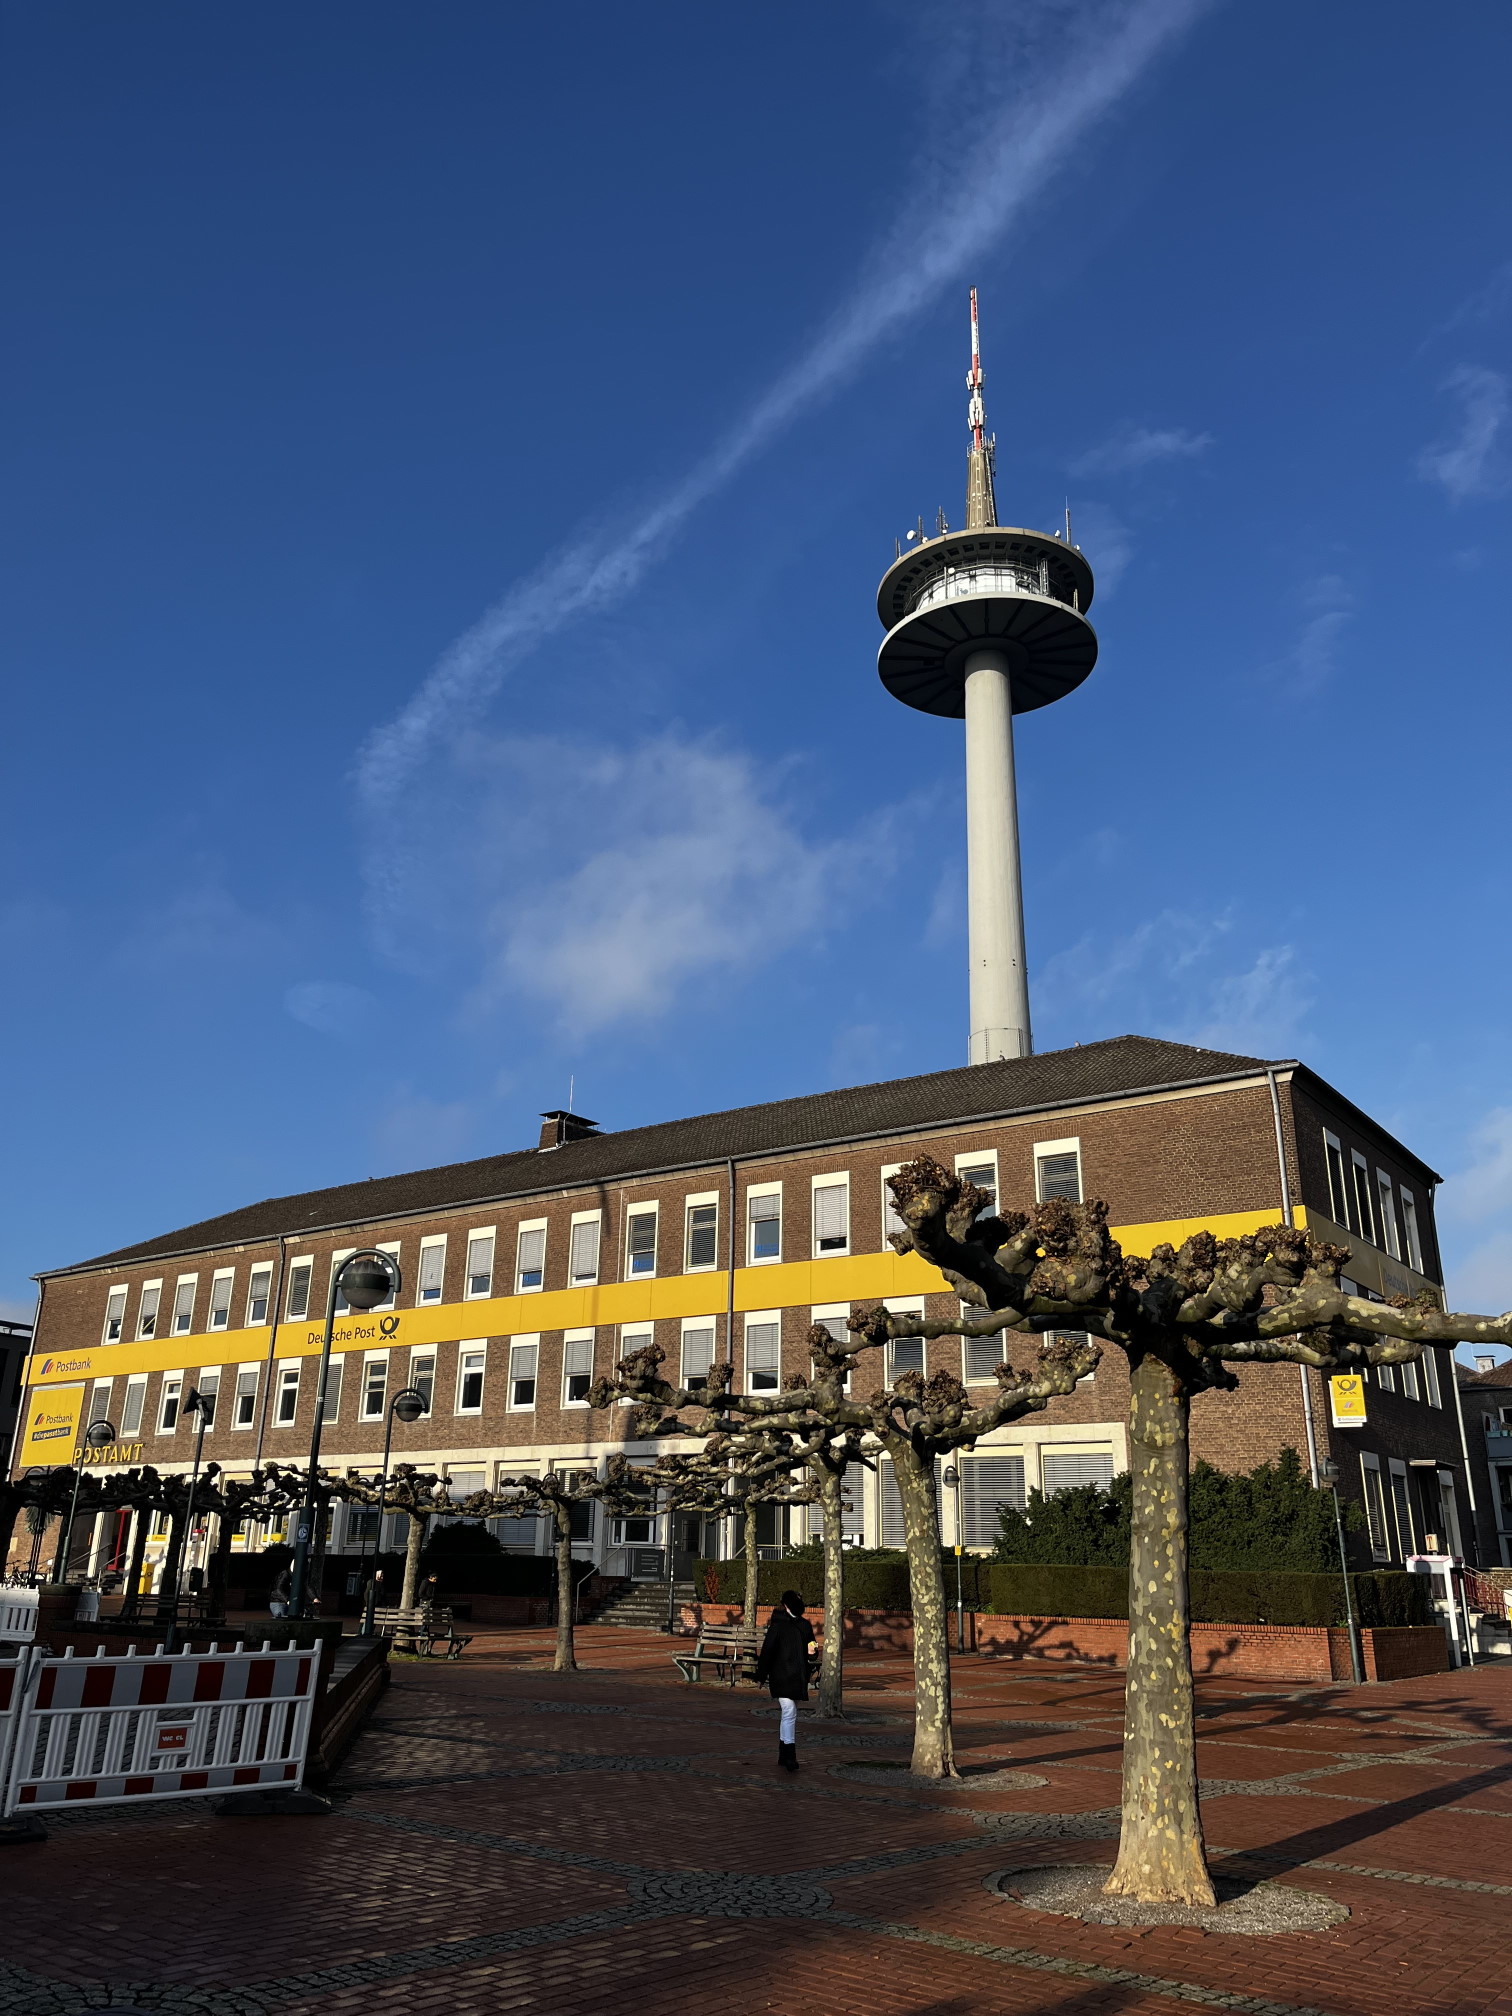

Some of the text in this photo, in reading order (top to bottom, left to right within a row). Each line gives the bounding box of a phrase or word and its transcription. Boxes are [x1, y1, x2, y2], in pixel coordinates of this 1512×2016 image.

[307, 1326, 375, 1344] Deusche Post
[55, 1357, 91, 1372] Postbank
[46, 1413, 73, 1424] Postbank
